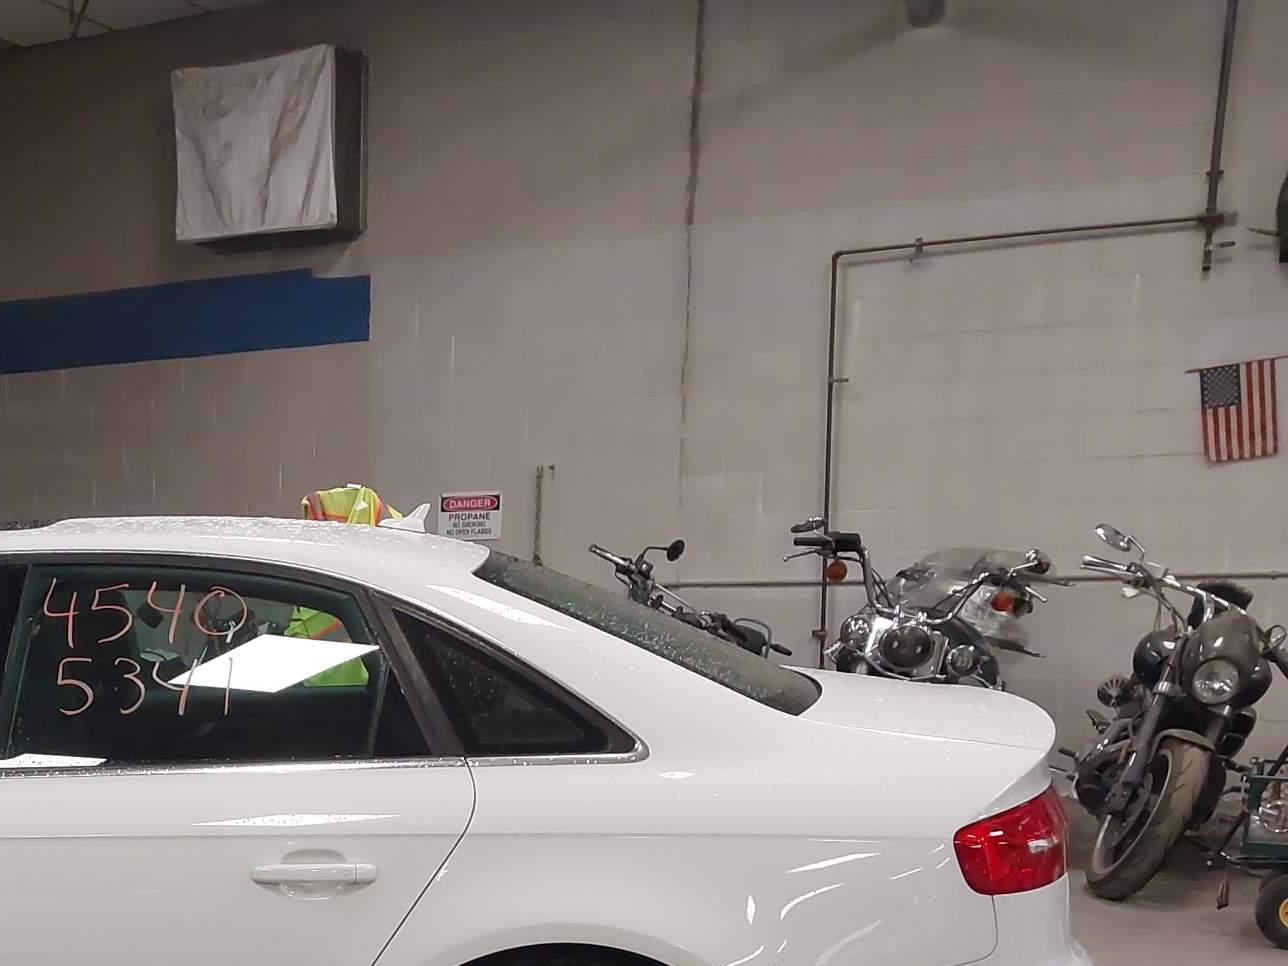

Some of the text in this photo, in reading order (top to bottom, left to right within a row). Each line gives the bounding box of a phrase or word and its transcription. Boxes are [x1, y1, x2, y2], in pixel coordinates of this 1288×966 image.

[448, 512, 491, 521] PROPANE
[449, 499, 491, 509] DANGER
[43, 577, 248, 648] 4540
[56, 656, 233, 717] 5341
